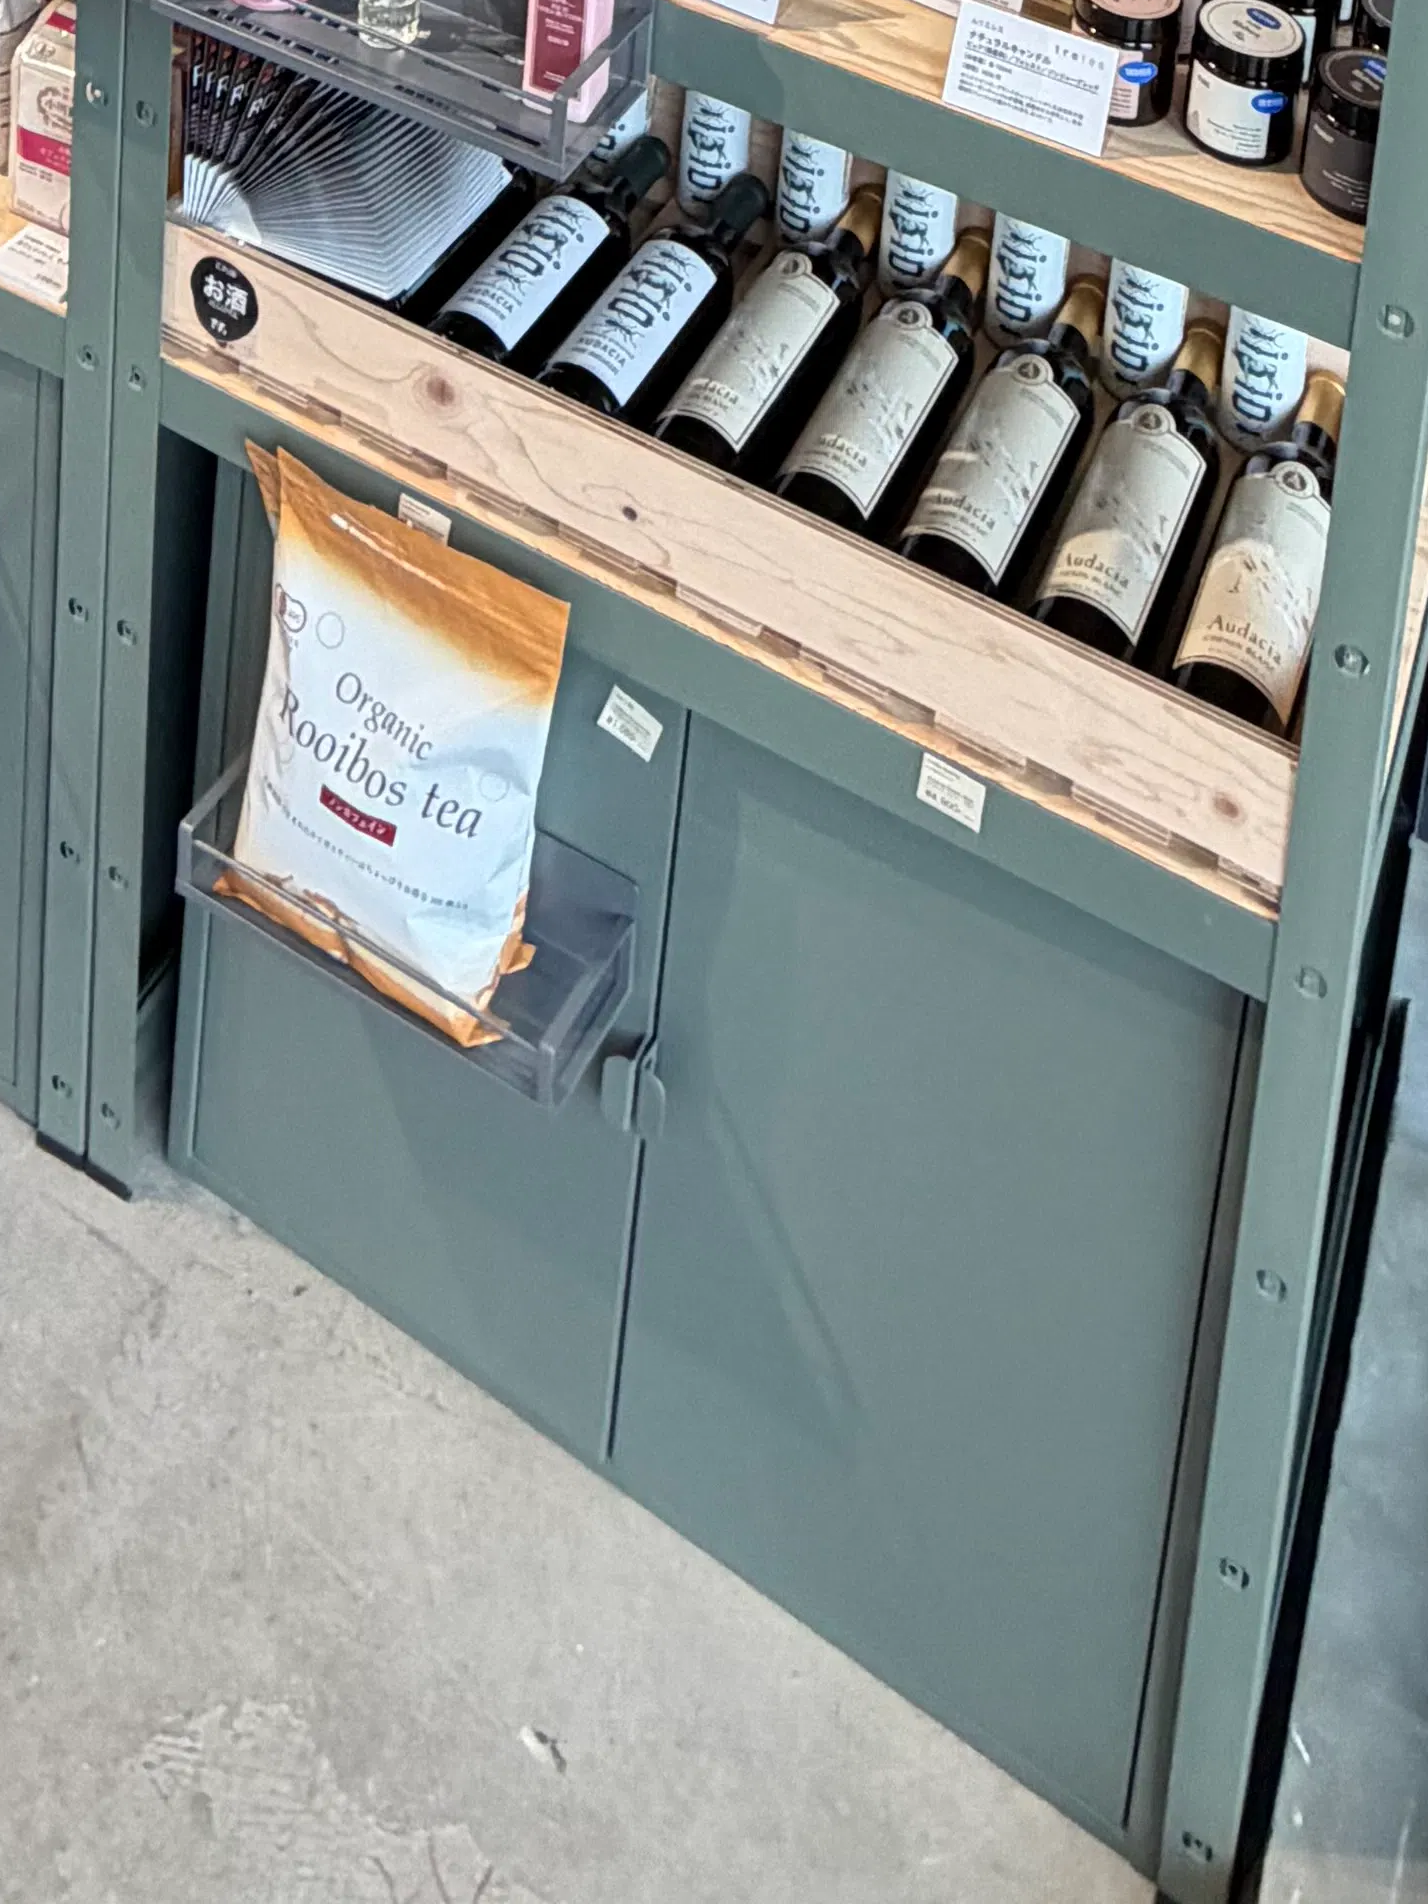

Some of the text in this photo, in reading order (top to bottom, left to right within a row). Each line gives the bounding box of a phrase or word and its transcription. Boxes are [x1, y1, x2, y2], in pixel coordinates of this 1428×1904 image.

[203, 274, 249, 317] お酒
[1205, 613, 1283, 666] Audacia
[335, 671, 434, 763] Organic
[277, 695, 484, 840] Rooibos tea
